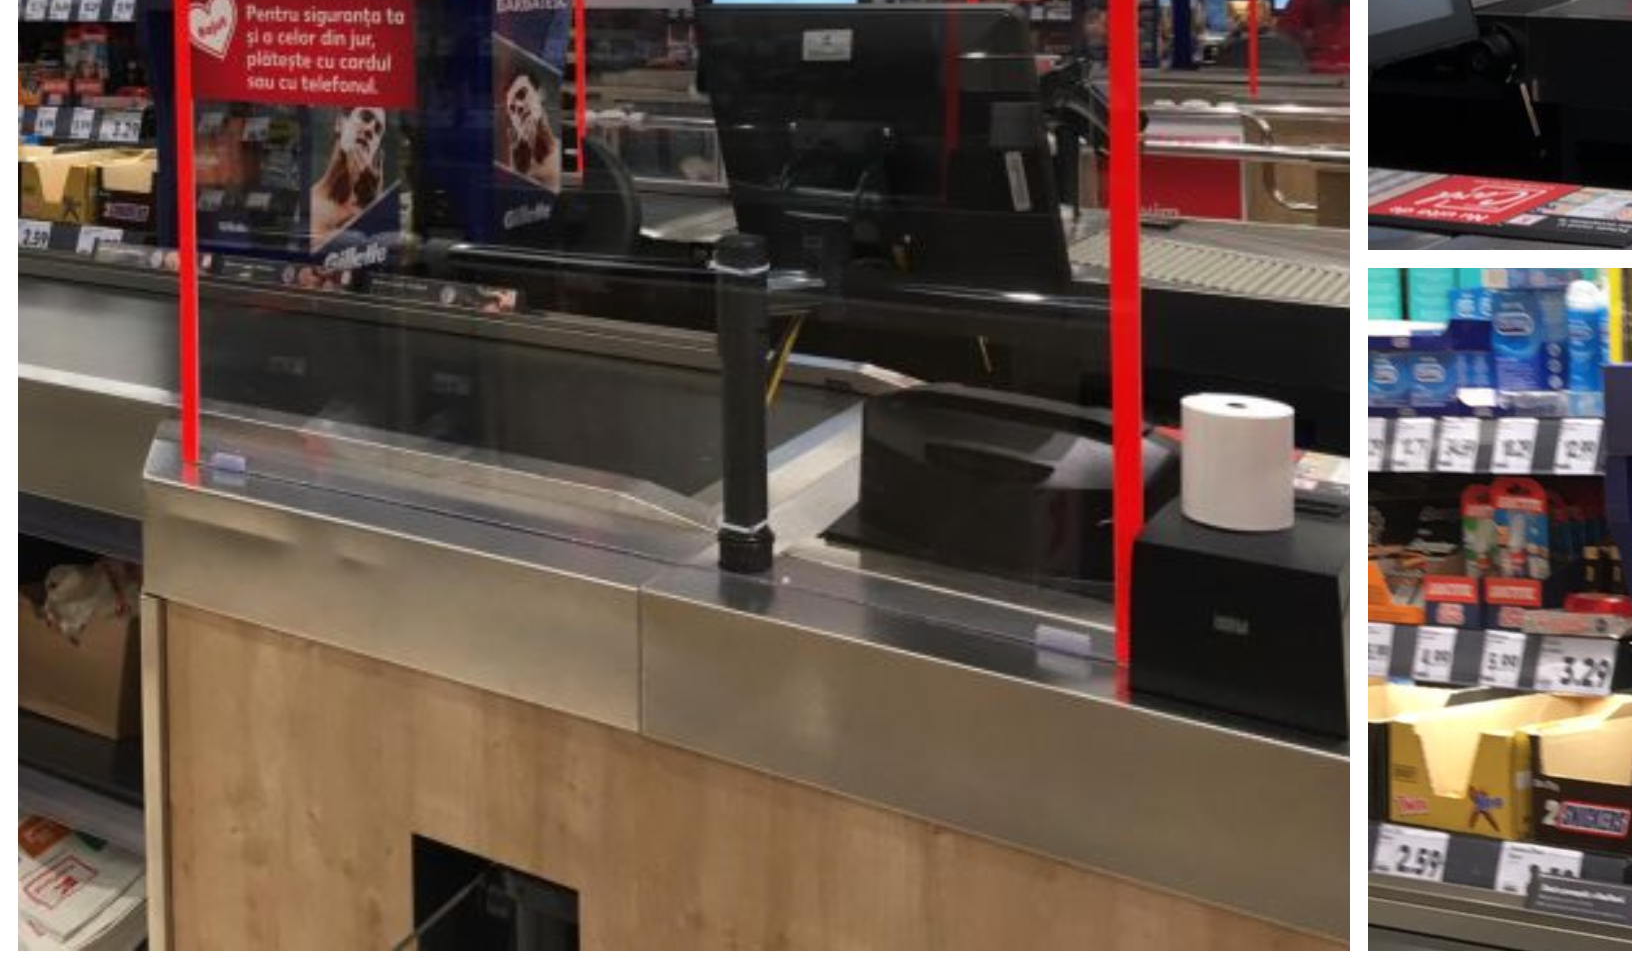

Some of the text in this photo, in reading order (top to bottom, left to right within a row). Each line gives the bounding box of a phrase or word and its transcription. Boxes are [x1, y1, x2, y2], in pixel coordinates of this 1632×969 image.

[246, 5, 405, 27] Pentru siguranța ta
[263, 32, 274, 44] a
[277, 30, 315, 46] celor
[319, 31, 347, 47] din
[316, 56, 335, 69] cu
[339, 53, 392, 72] cardul
[247, 75, 275, 89] sau
[278, 76, 298, 90] cu
[324, 242, 387, 270] Gillette
[1560, 656, 1610, 688] 3.29
[1396, 843, 1442, 876] 2.59
